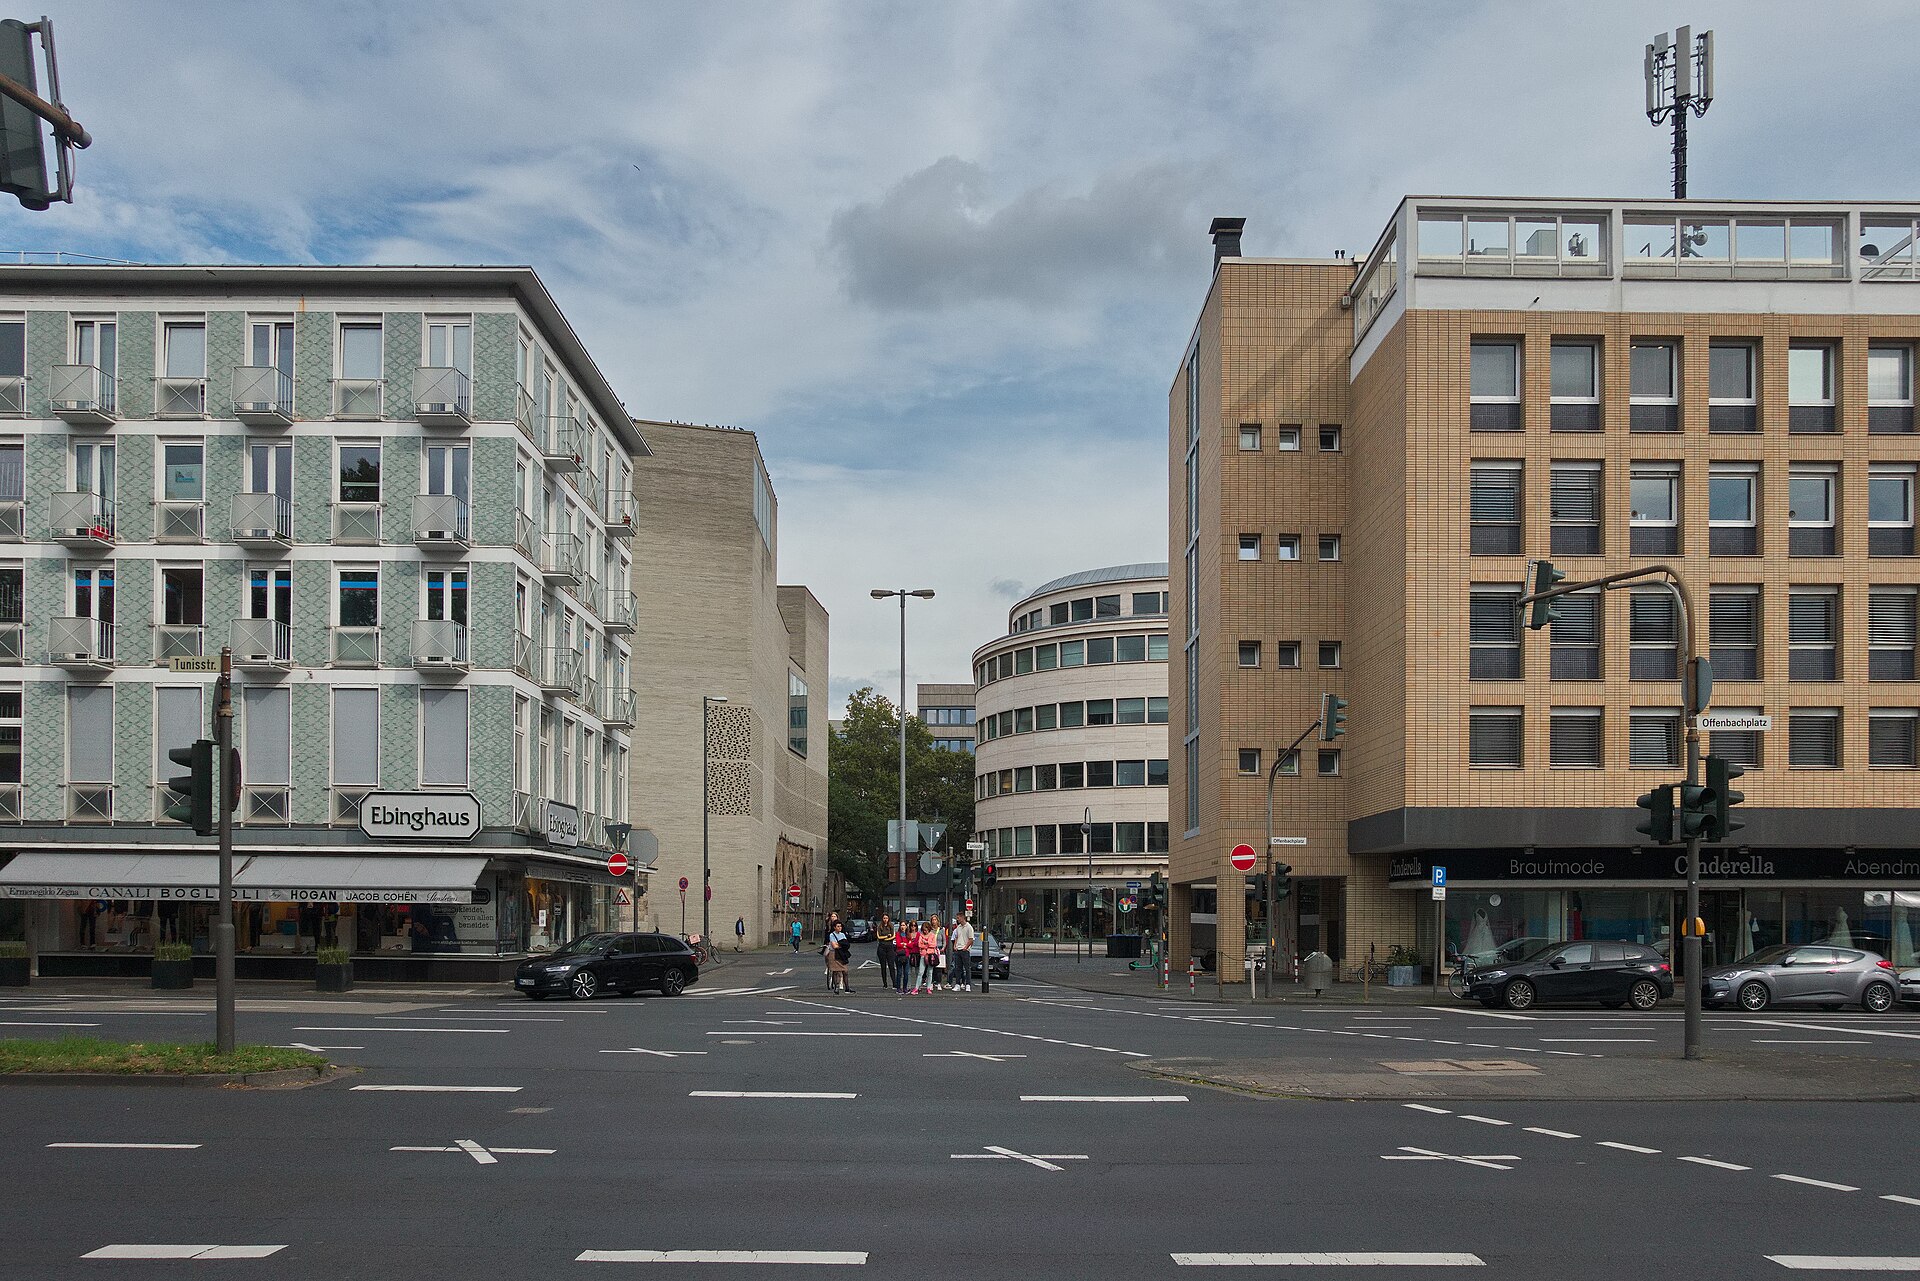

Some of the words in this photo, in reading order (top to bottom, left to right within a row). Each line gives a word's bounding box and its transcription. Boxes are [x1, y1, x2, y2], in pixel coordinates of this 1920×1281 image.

[174, 658, 217, 670] Tunisstr.
[1702, 718, 1768, 728] Offenbachplatz
[371, 806, 470, 831] Ebinghaus
[549, 814, 577, 839] Ebinghaus
[1390, 857, 1422, 877] Cinderella
[1510, 859, 1605, 875] Brautmode
[1674, 856, 1775, 875] Cnderella
[1844, 859, 1920, 875] Abendm
[9, 888, 56, 897] Ermenegildo
[56, 888, 79, 896] Zegna
[88, 887, 150, 898] CANALI
[160, 888, 259, 899] BOGLOLI
[290, 890, 337, 900] HOGAN
[345, 892, 380, 901] JACOB
[383, 890, 417, 901] COHËN
